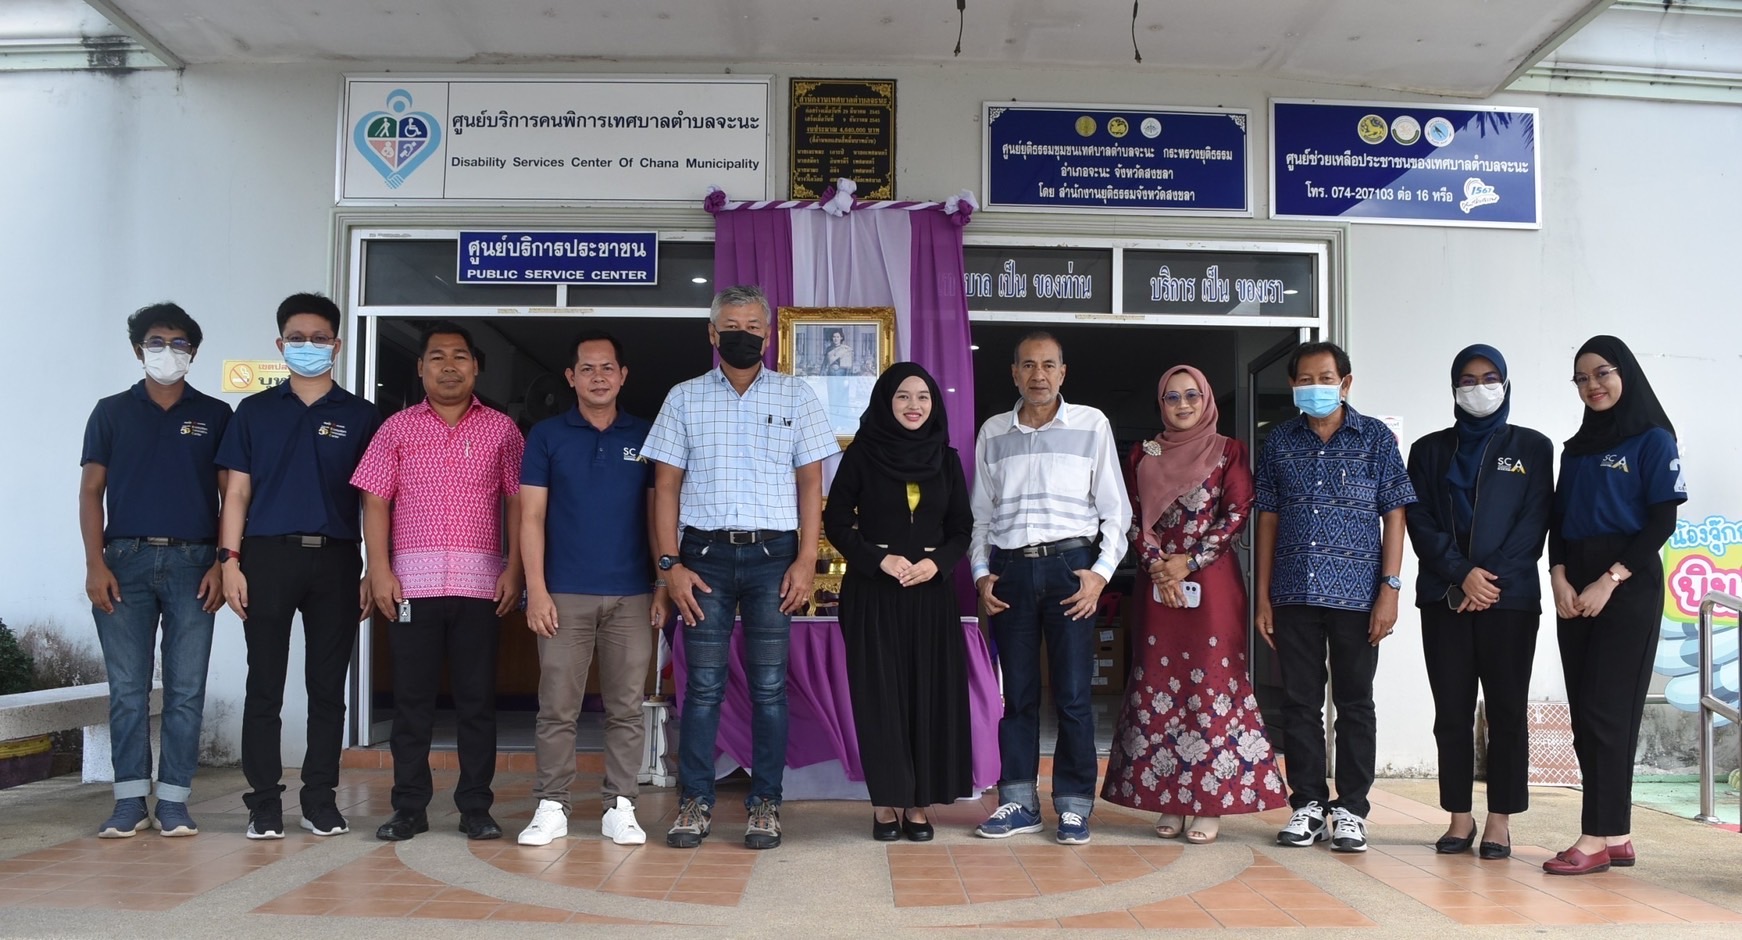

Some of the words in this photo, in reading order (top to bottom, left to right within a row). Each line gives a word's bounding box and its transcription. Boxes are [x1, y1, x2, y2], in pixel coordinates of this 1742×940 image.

[452, 109, 760, 135] ศูนย์บริการคนพิการเทศบาลตำบลจะนะ
[451, 156, 506, 169] Disability
[512, 157, 564, 168] Services
[571, 157, 613, 168] Center
[619, 157, 634, 168] Of
[639, 157, 679, 169] Chana
[686, 158, 760, 171] Municipality
[1002, 140, 1155, 160] ศูนย์ยุติธรรมชุมชนเทศบาลตำบลจะนะ
[1163, 145, 1233, 165] กระทรวงยุติธรรม
[1286, 148, 1529, 173] ศูนย์ช่วยเหลือประชาชนของเทศบาลตำบลจะนะ
[1061, 162, 1111, 178] อำเภอจะนะ
[1114, 164, 1174, 180] จังหวัดสงขลา
[1038, 182, 1055, 198] โดย
[1059, 183, 1196, 204] สำนักงานยุติธรรมจังหวัดสงขลา
[1305, 181, 1328, 199] โทร.
[1331, 186, 1394, 201] 074-207103
[1397, 185, 1412, 201] ต่อ
[1416, 189, 1429, 202] 16
[1432, 186, 1453, 203] หรือ
[1471, 186, 1492, 196] 1567
[468, 235, 647, 265] ศูนย์บริการประชาชน
[467, 269, 518, 279] PUBLIC
[525, 269, 585, 280] SERVICE
[591, 270, 647, 280] CENTER
[998, 259, 1027, 298] เป็น
[1033, 261, 1092, 300] ของท่าน
[1150, 265, 1196, 302] บริการ
[1201, 265, 1230, 303] เป็น
[1235, 277, 1285, 304] ของเรา
